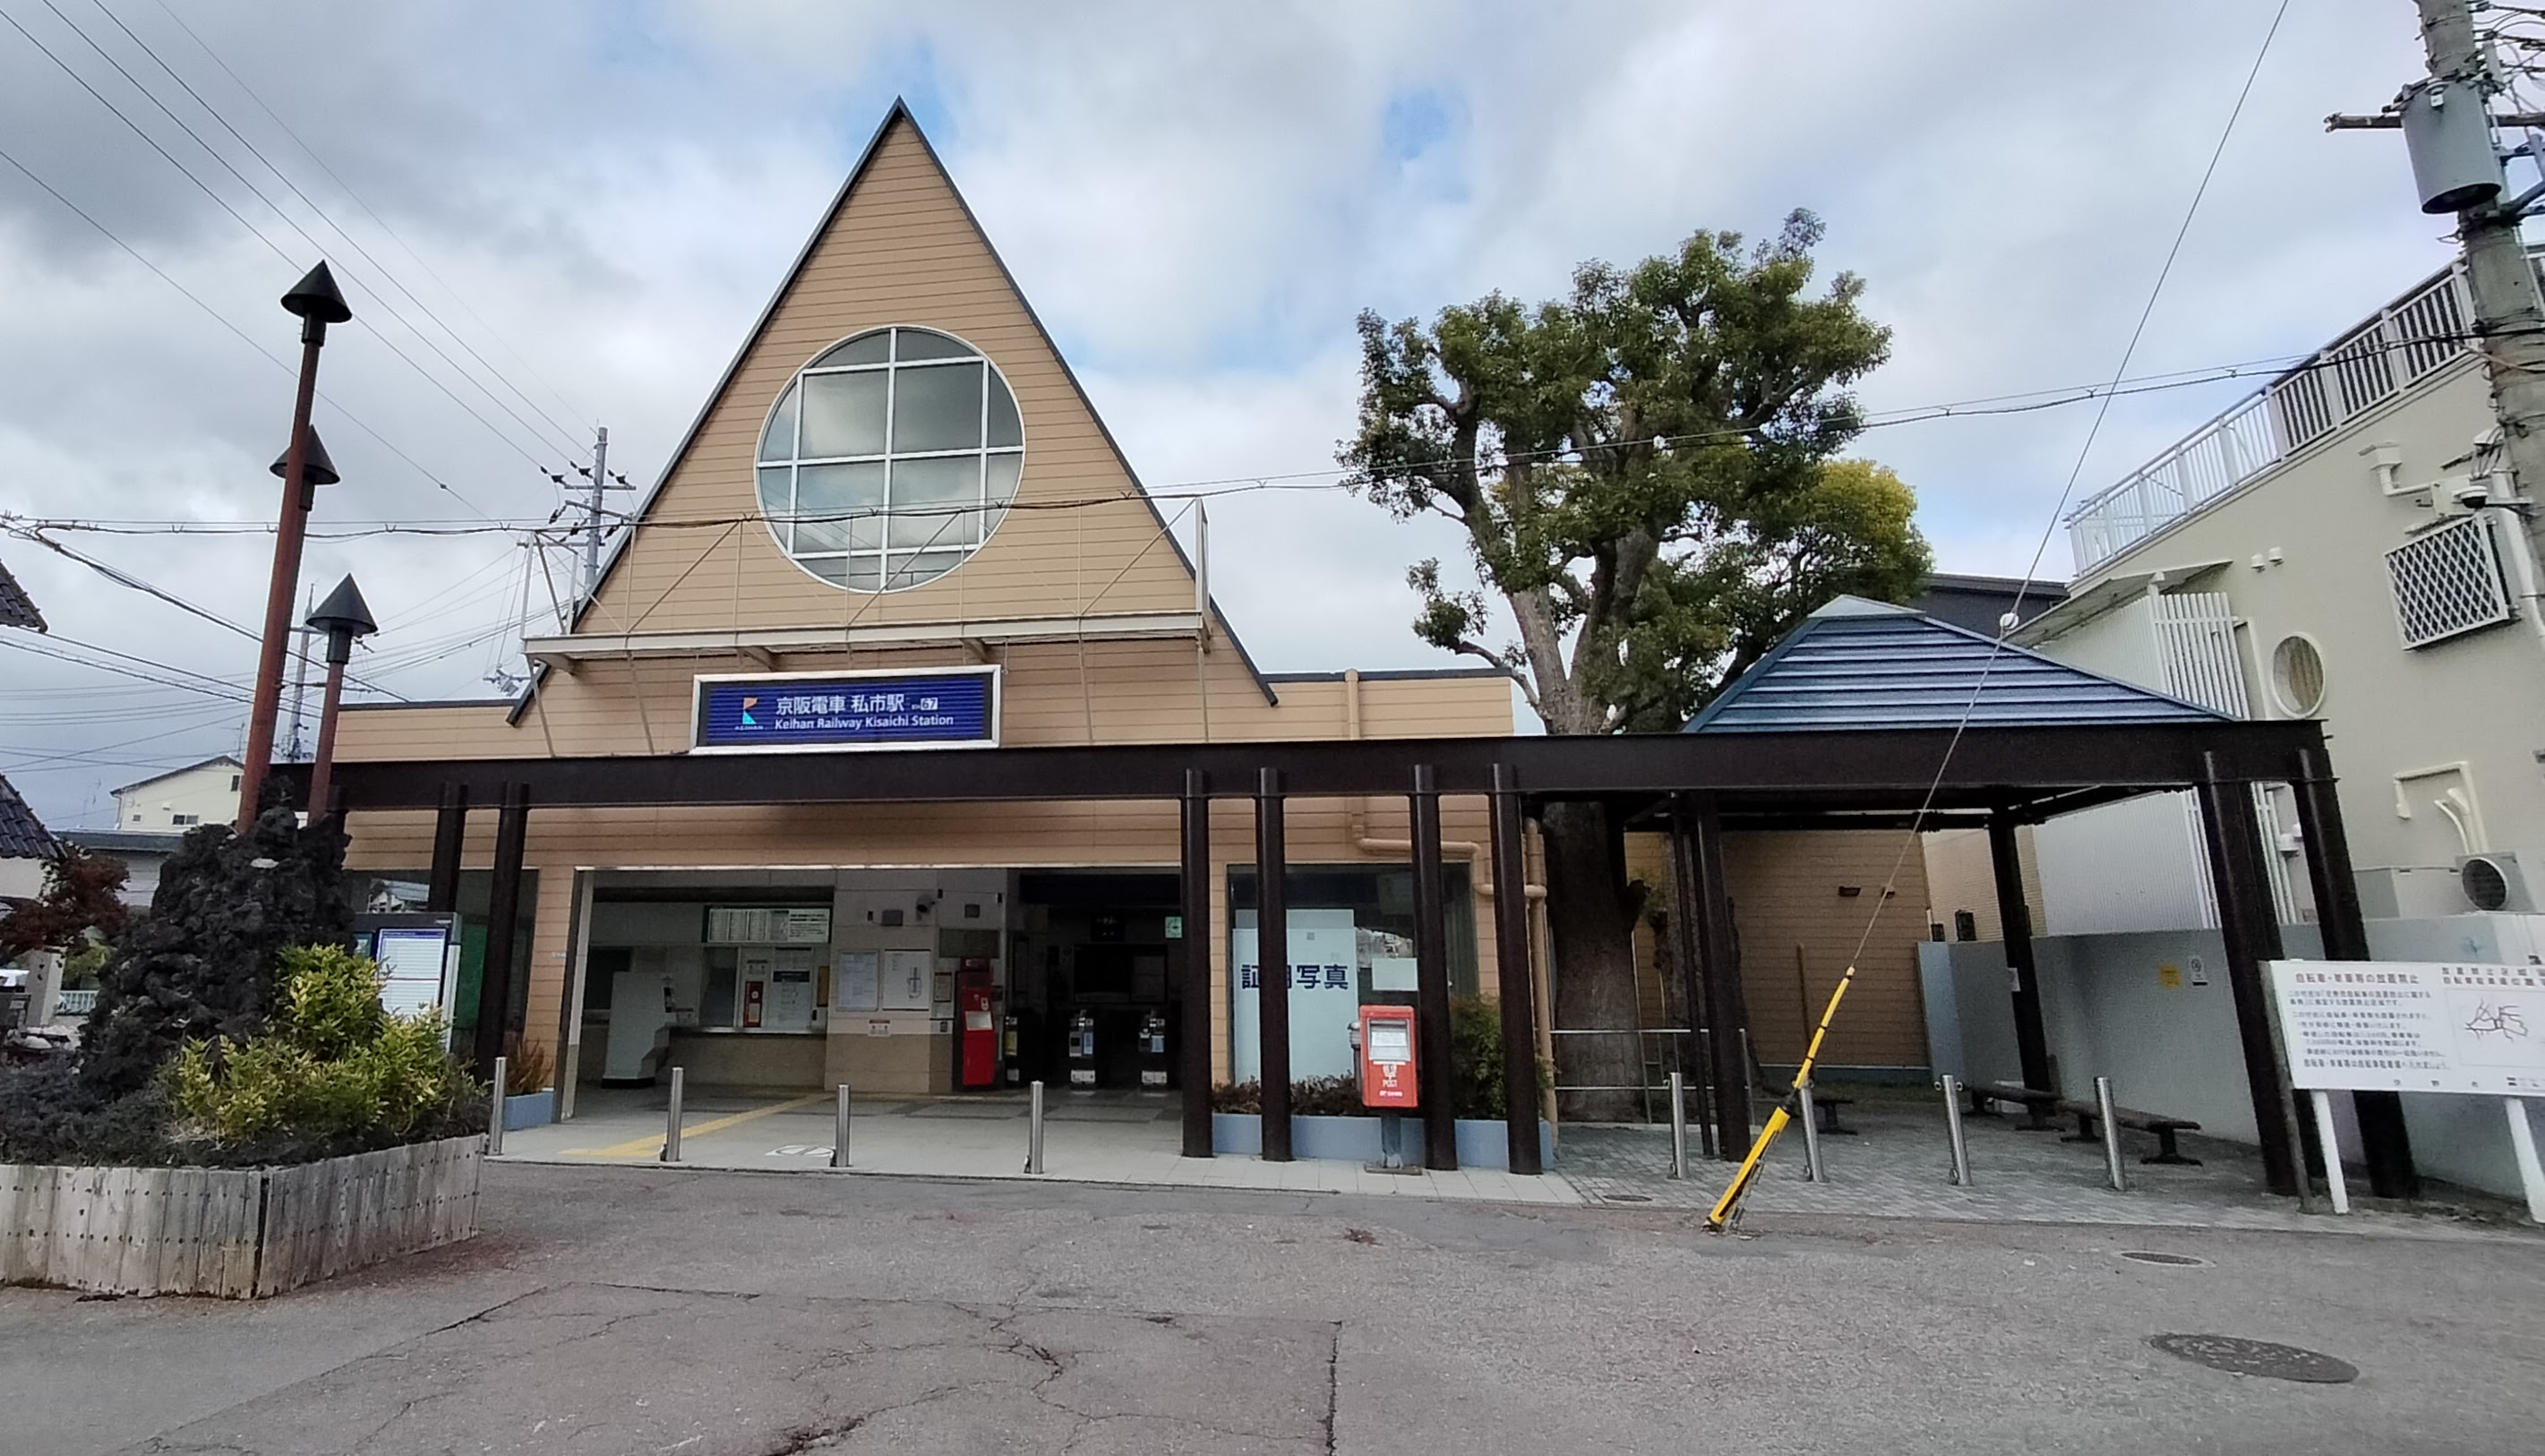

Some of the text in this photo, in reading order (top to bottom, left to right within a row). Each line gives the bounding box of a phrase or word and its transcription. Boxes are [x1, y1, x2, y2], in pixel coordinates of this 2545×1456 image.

[775, 694, 904, 715] 京阪電車 私市駅
[921, 698, 937, 709] 67
[775, 714, 954, 730] Keihan Railway Kisaichi Station
[1241, 964, 1349, 990] 証写真
